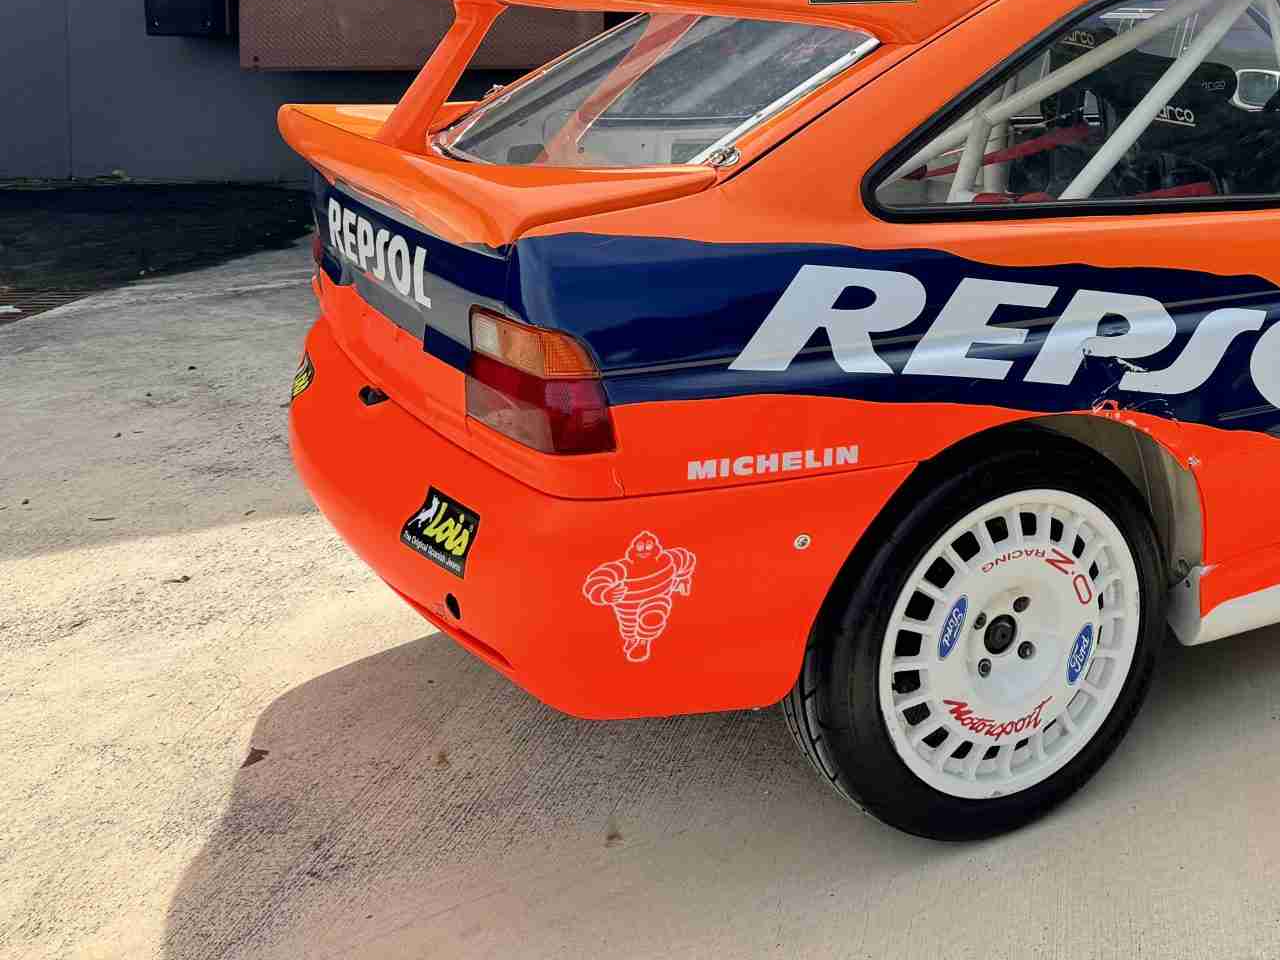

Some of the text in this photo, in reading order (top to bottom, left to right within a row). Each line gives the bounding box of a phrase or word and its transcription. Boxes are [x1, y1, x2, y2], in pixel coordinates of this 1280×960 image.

[328, 197, 432, 309] REPSOL
[687, 444, 859, 481] MICHELIN
[423, 502, 470, 556] Lois
[981, 547, 1046, 573] RACING
[941, 604, 966, 651] Ford
[1069, 630, 1092, 678] Ford
